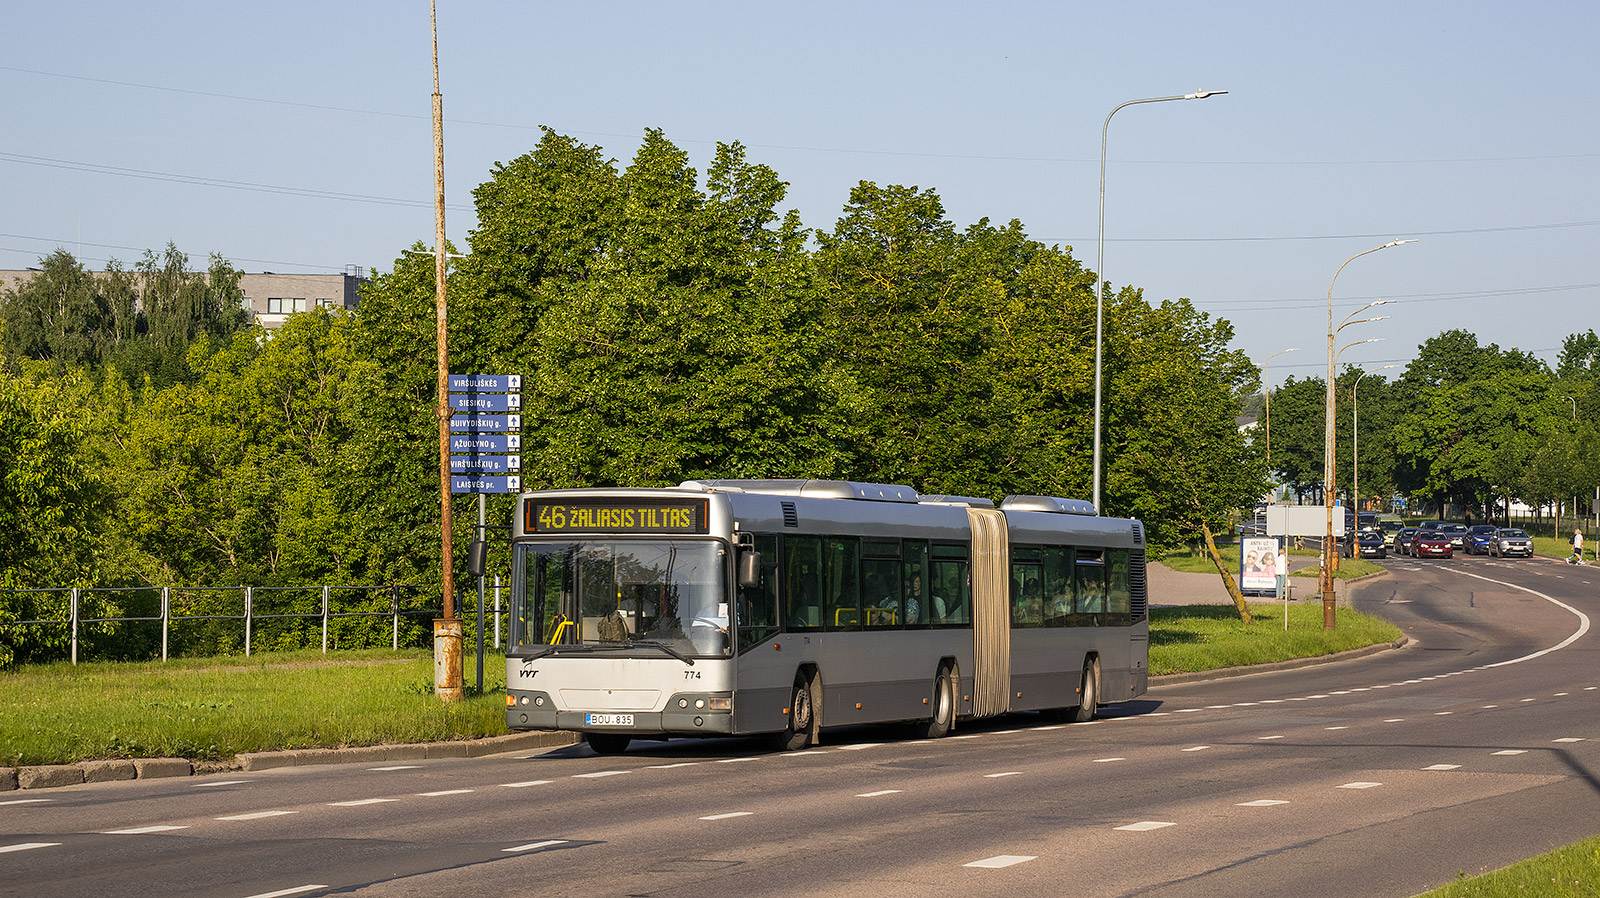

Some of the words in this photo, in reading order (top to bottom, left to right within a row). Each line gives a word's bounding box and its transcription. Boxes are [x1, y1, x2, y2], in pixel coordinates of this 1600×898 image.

[453, 378, 498, 387] VIRŠULIŠKĖS
[459, 399, 486, 408] SIESIKŲ
[486, 400, 494, 408] g.
[451, 419, 494, 428] BUIVYDIŠKIŲ
[494, 421, 502, 429] g.
[454, 439, 489, 449] ĄŽUOLYNO
[490, 441, 497, 449] g.
[450, 459, 493, 469] VIRŠULIŠKIŲ
[494, 461, 501, 469] g.
[456, 480, 485, 488] LAISVĖS
[485, 482, 495, 490] pr.
[539, 505, 566, 529] 46
[570, 506, 635, 527] ŽALIASIS
[638, 508, 690, 528] TILTAS
[684, 671, 701, 679] 774
[591, 715, 611, 724] BOU
[615, 715, 632, 724] 835
